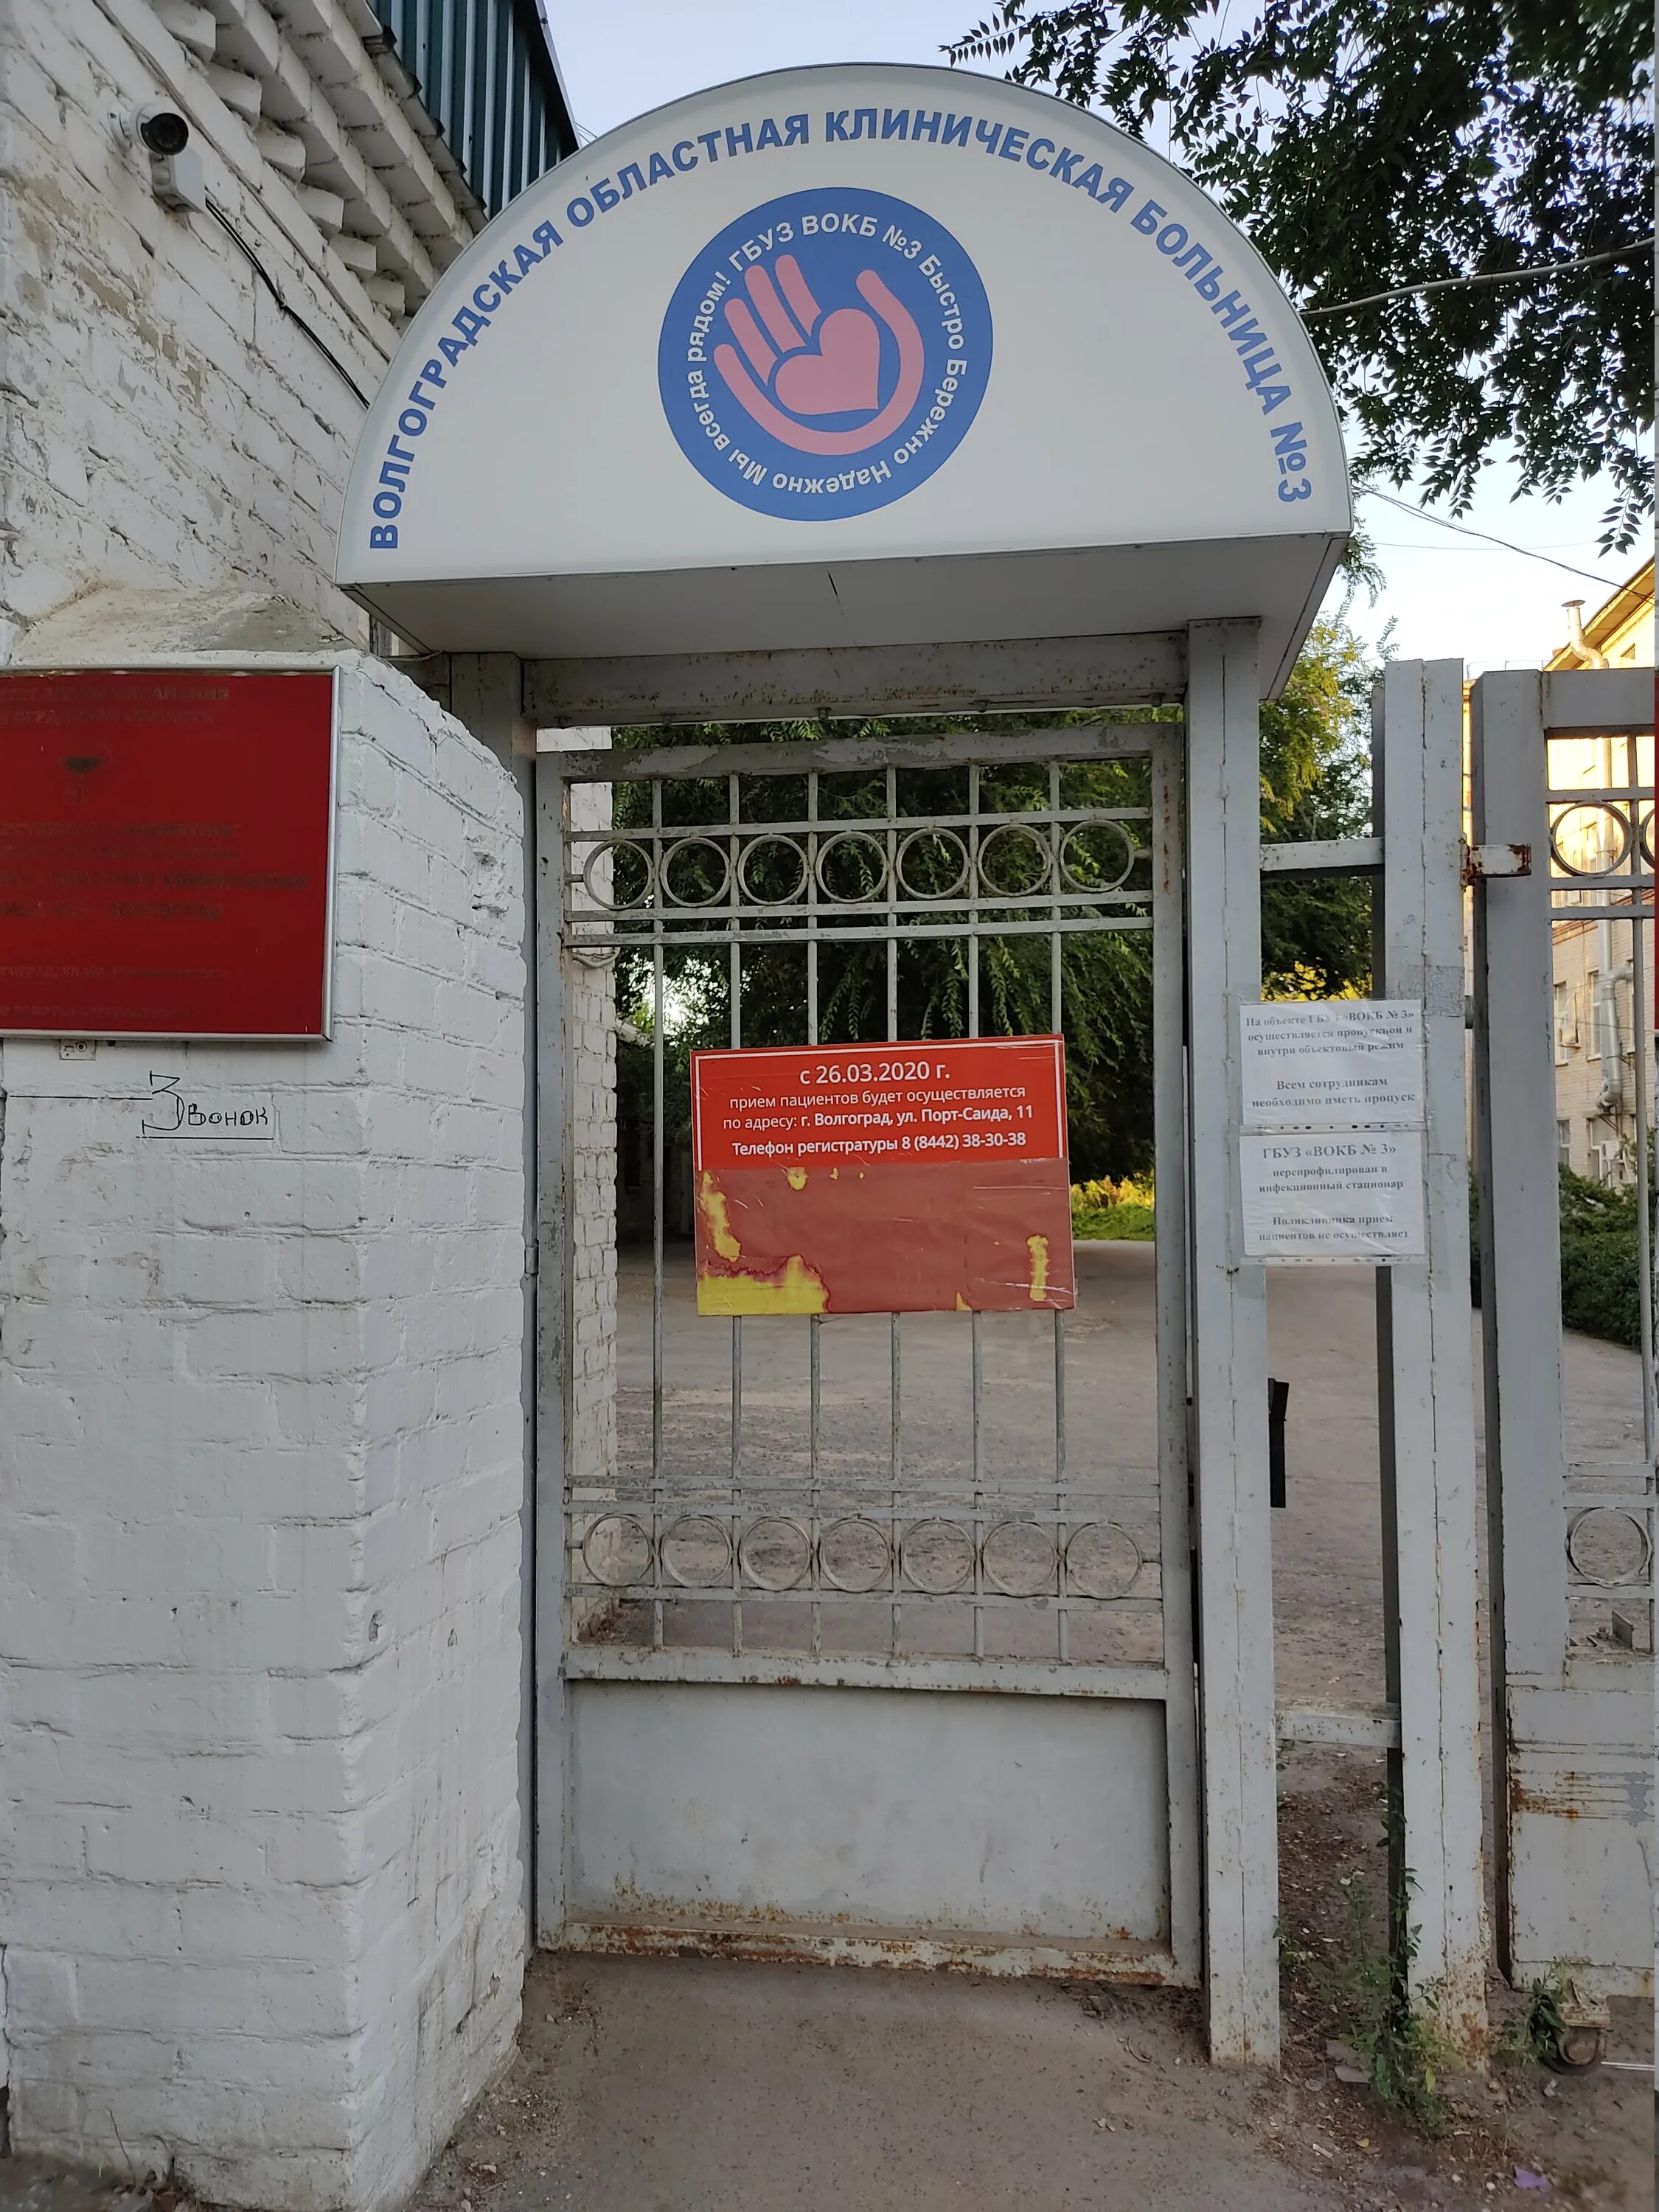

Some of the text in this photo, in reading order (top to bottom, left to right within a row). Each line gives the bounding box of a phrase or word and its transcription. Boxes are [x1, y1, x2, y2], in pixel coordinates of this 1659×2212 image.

[369, 108, 1312, 550] ВОЛГОГРАДСКАЯ ОБЛАСТНАЯ КЛИНИЧЕСКАЯ БОЛЬНИЦА №3
[686, 212, 968, 495] ГБУЗ ВОКБ №3 Быстро Бережно Надежно Мы всегда рядом!
[1246, 1018, 1261, 1026] На
[1264, 1017, 1306, 1026] объекте
[1385, 1010, 1399, 1019] №
[1401, 1009, 1414, 1019] 3»
[1248, 1031, 1334, 1043] осуществляется
[1257, 1047, 1295, 1057] внутри
[799, 1061, 950, 1085] с 26.03.2020 г.
[1276, 1078, 1388, 1090] Всем сотрудникам
[729, 1086, 1026, 1111] прием пациентов будет осуществляется
[1252, 1093, 1416, 1107] необходимо иметь пропуск
[723, 1105, 1033, 1132] по адресу: г. Волгоград, ул. Порт-Саида, 11
[731, 1133, 1027, 1158] Телефон регистратуры 8 (8442) 38-30-38
[1262, 1144, 1397, 1159] ГБУЗ «ВОКБ № 3»
[1273, 1166, 1378, 1178] перепрофилирован
[1259, 1180, 1404, 1194] инфекционный стационар
[1259, 1232, 1315, 1241] пациентов
